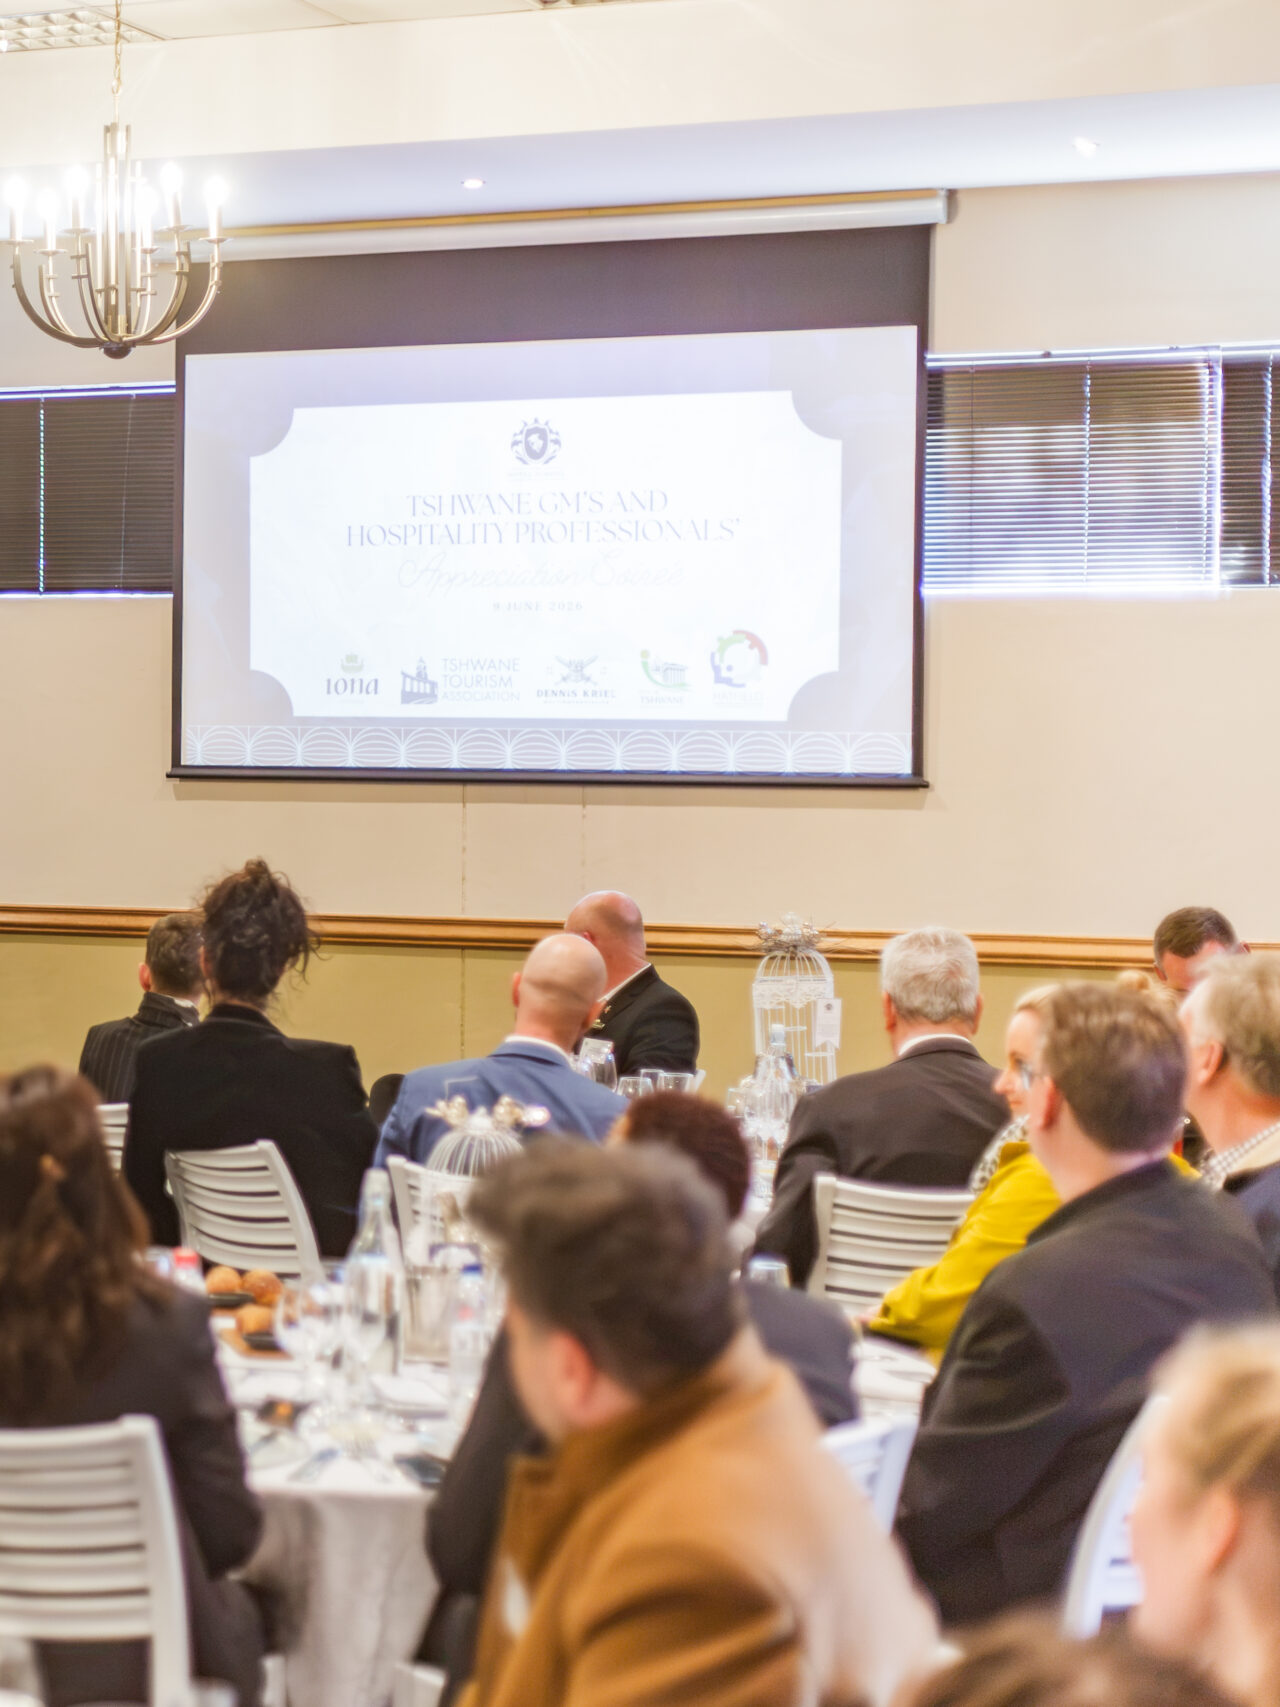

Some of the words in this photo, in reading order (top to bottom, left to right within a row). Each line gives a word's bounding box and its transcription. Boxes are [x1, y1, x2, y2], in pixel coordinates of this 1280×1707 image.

[406, 491, 531, 517] TSHWANE
[538, 490, 604, 515] GM'S
[614, 487, 669, 513] AND
[346, 522, 510, 547] HOSPITALITY
[397, 550, 586, 598] Appreciation
[506, 600, 544, 611] JUNE
[442, 657, 520, 673] TSHWANE
[441, 673, 514, 689] TOURISM
[441, 690, 520, 703] ASSOCIATION
[536, 688, 578, 699] DENNIS
[582, 687, 617, 699] KRIEL
